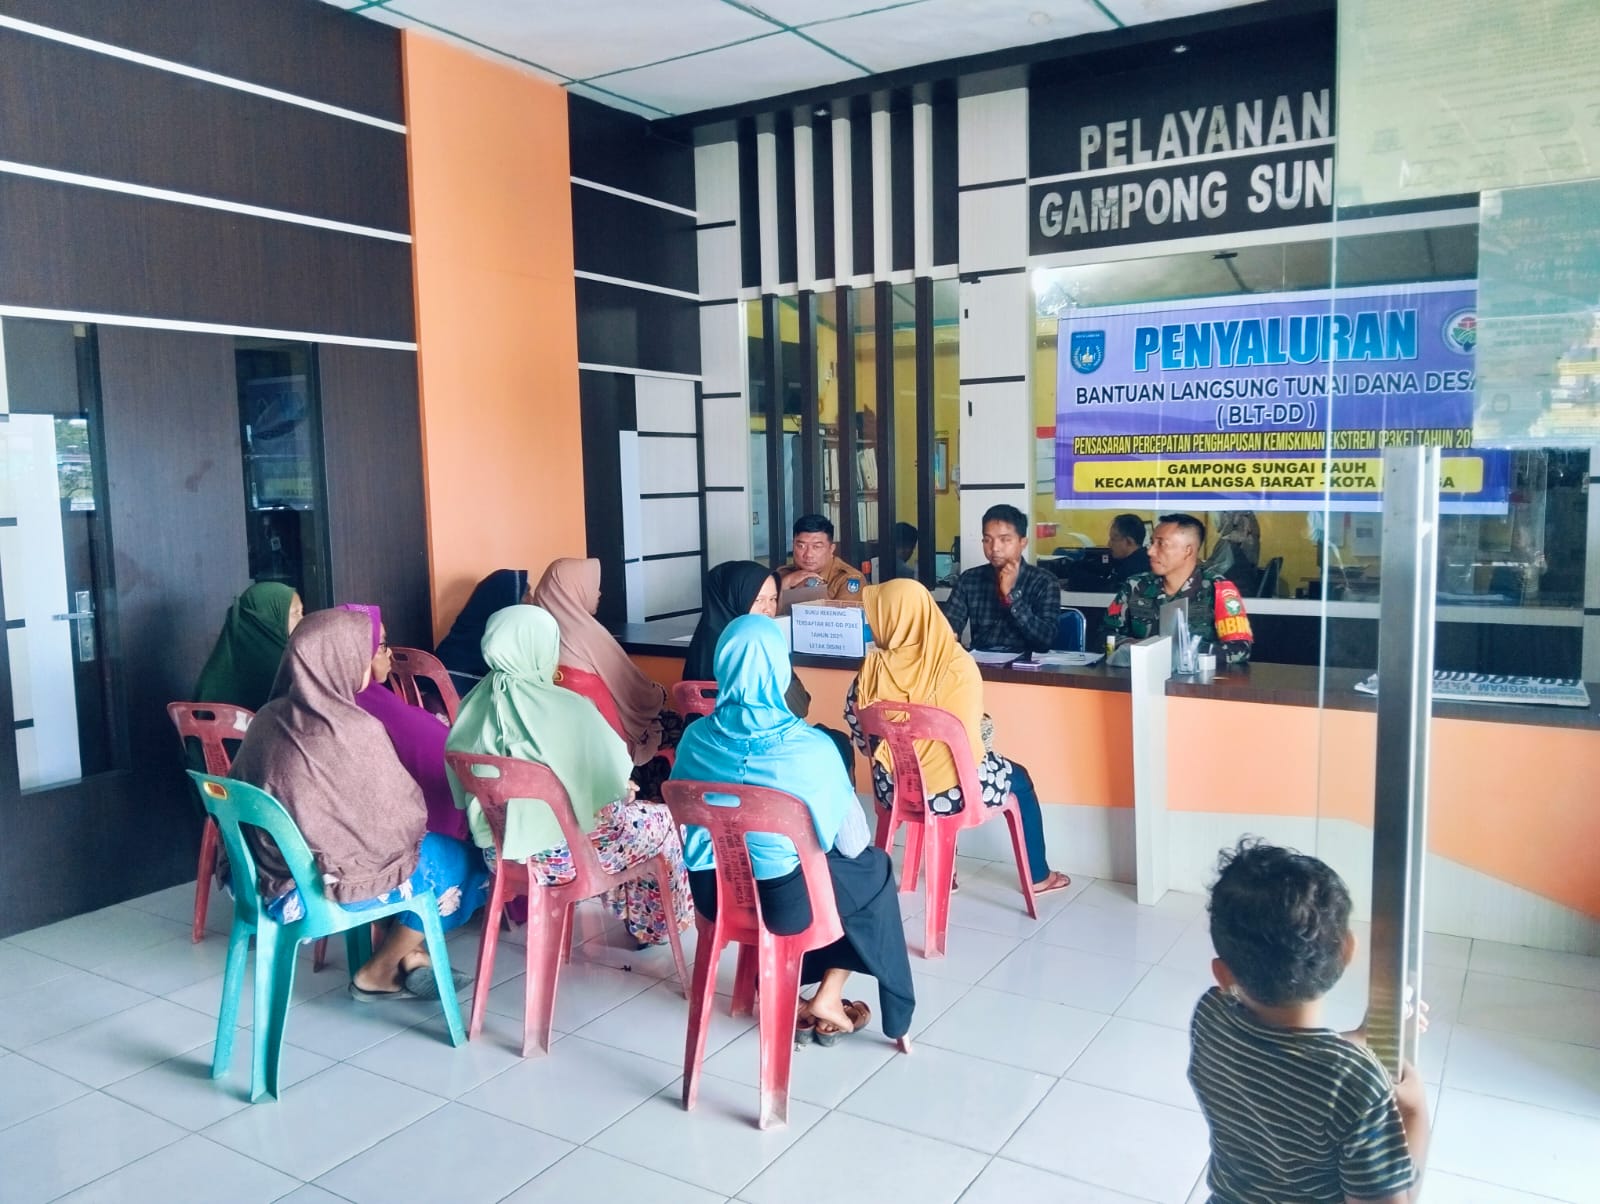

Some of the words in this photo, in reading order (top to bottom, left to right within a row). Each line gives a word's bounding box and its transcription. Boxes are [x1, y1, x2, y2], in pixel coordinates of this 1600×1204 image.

[1080, 89, 1329, 171] PELAYANAN
[1039, 171, 1228, 238] GAMPONG
[1248, 158, 1333, 213] SUN
[1133, 309, 1418, 372] PENYALURAN
[1076, 384, 1165, 404] BANTUAN
[1171, 378, 1278, 401] LANGSUNG
[1284, 375, 1347, 397] TUNAI
[1355, 373, 1418, 394] DANA
[1074, 436, 1131, 455] PENSASARAN
[1133, 435, 1191, 453] PERCEPATAN
[1193, 433, 1261, 452] PENGHAPUSAN
[1264, 431, 1325, 451] KEMISKINAN
[1417, 429, 1453, 448] TAHUN
[1456, 429, 1473, 448] 20
[1095, 477, 1186, 489] KECAMATAN
[1191, 477, 1255, 488] LANGSA
[1262, 476, 1315, 488] BARAT
[1329, 476, 1376, 488] KOTA
[1168, 463, 1246, 475] GAMPONG
[1252, 462, 1315, 474] SUNGAI
